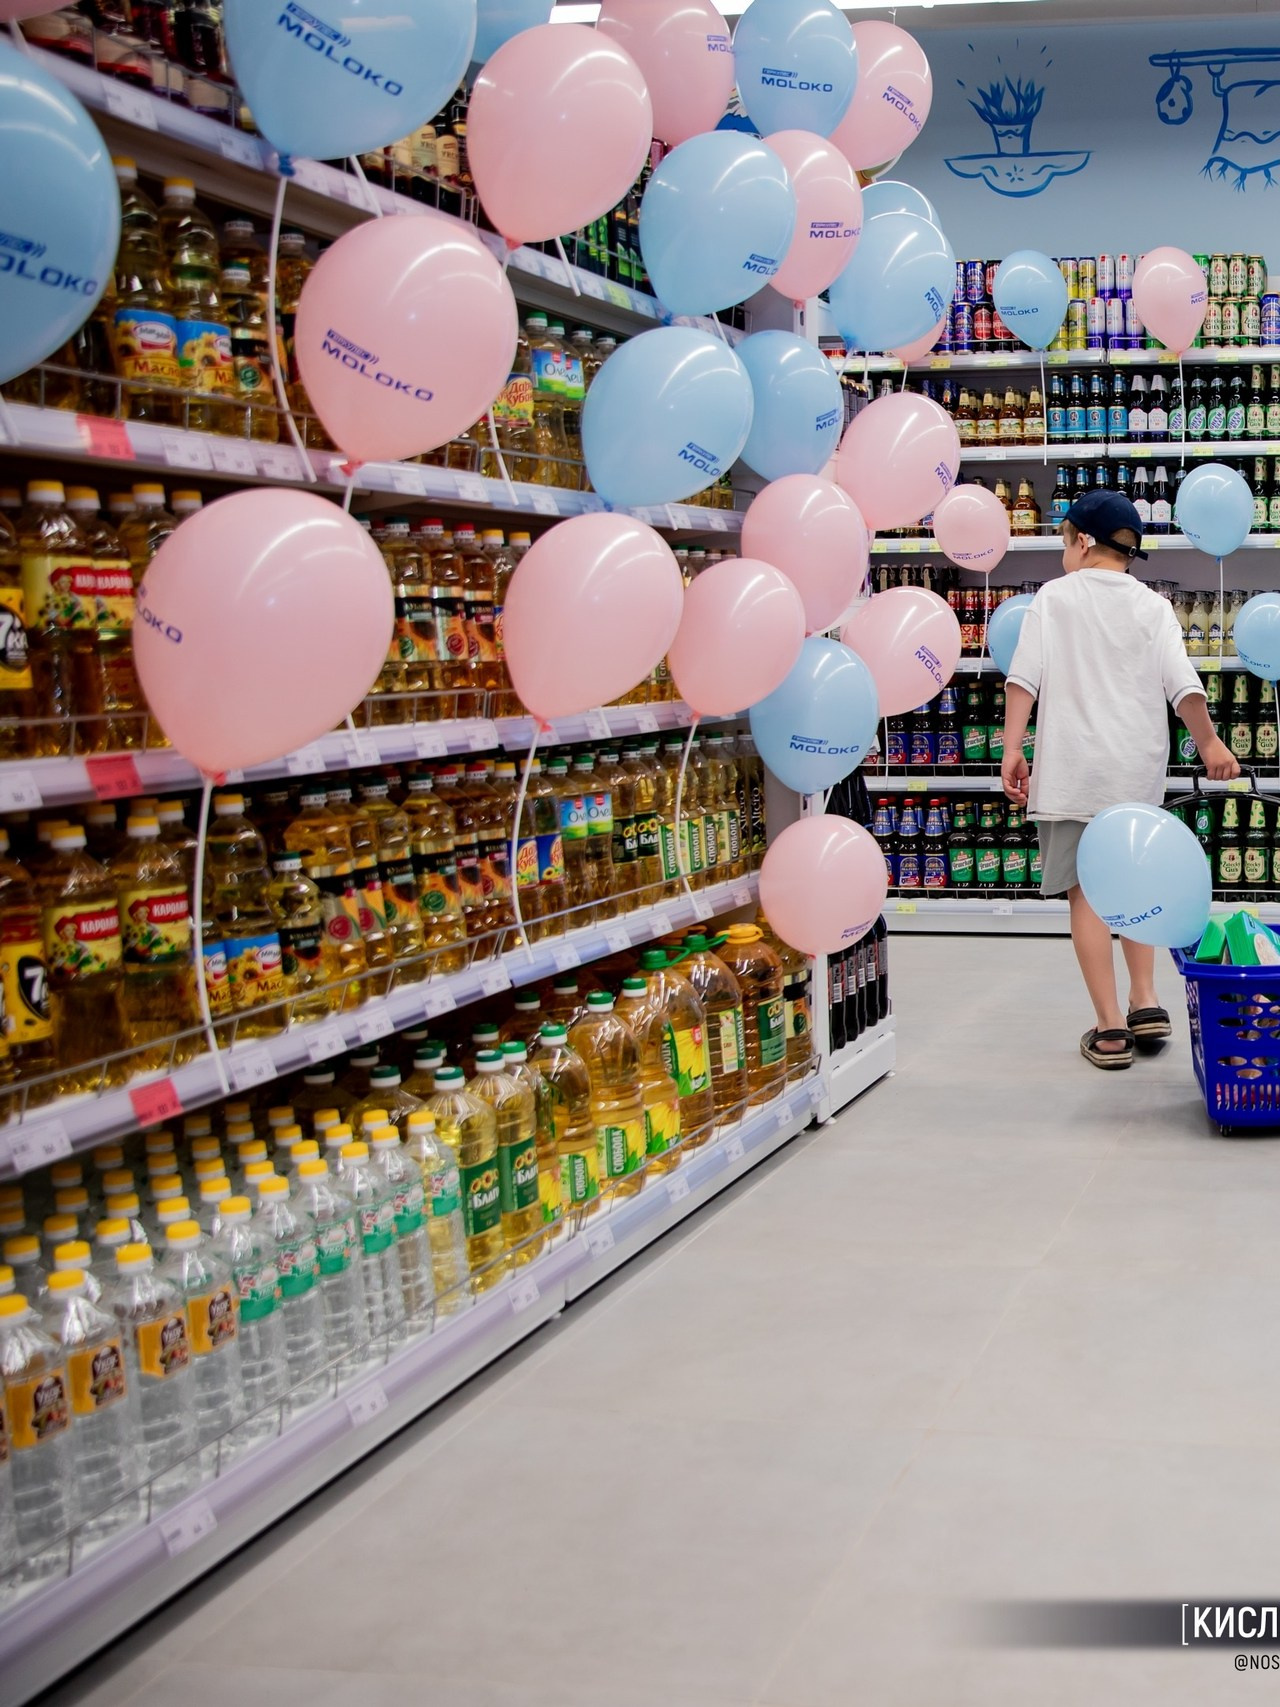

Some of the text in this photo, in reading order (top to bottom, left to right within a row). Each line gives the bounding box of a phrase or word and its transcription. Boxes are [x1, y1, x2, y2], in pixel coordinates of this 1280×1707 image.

[277, 13, 403, 97] MOLOKO
[761, 76, 833, 93] MOLOKO
[0, 258, 98, 298] OLOKO
[1001, 307, 1039, 316] MOLOKO
[321, 339, 435, 402] MOLOKO
[678, 448, 722, 477] MOLO
[952, 549, 994, 561] MOLOKO
[914, 649, 945, 691] MOLOK
[790, 740, 859, 755] MOLOKO
[1107, 905, 1163, 929] MOLOKO
[24, 965, 46, 1004] 7
[611, 1129, 625, 1174] СЛОБОДА
[574, 1156, 586, 1199] СЛОБОДА
